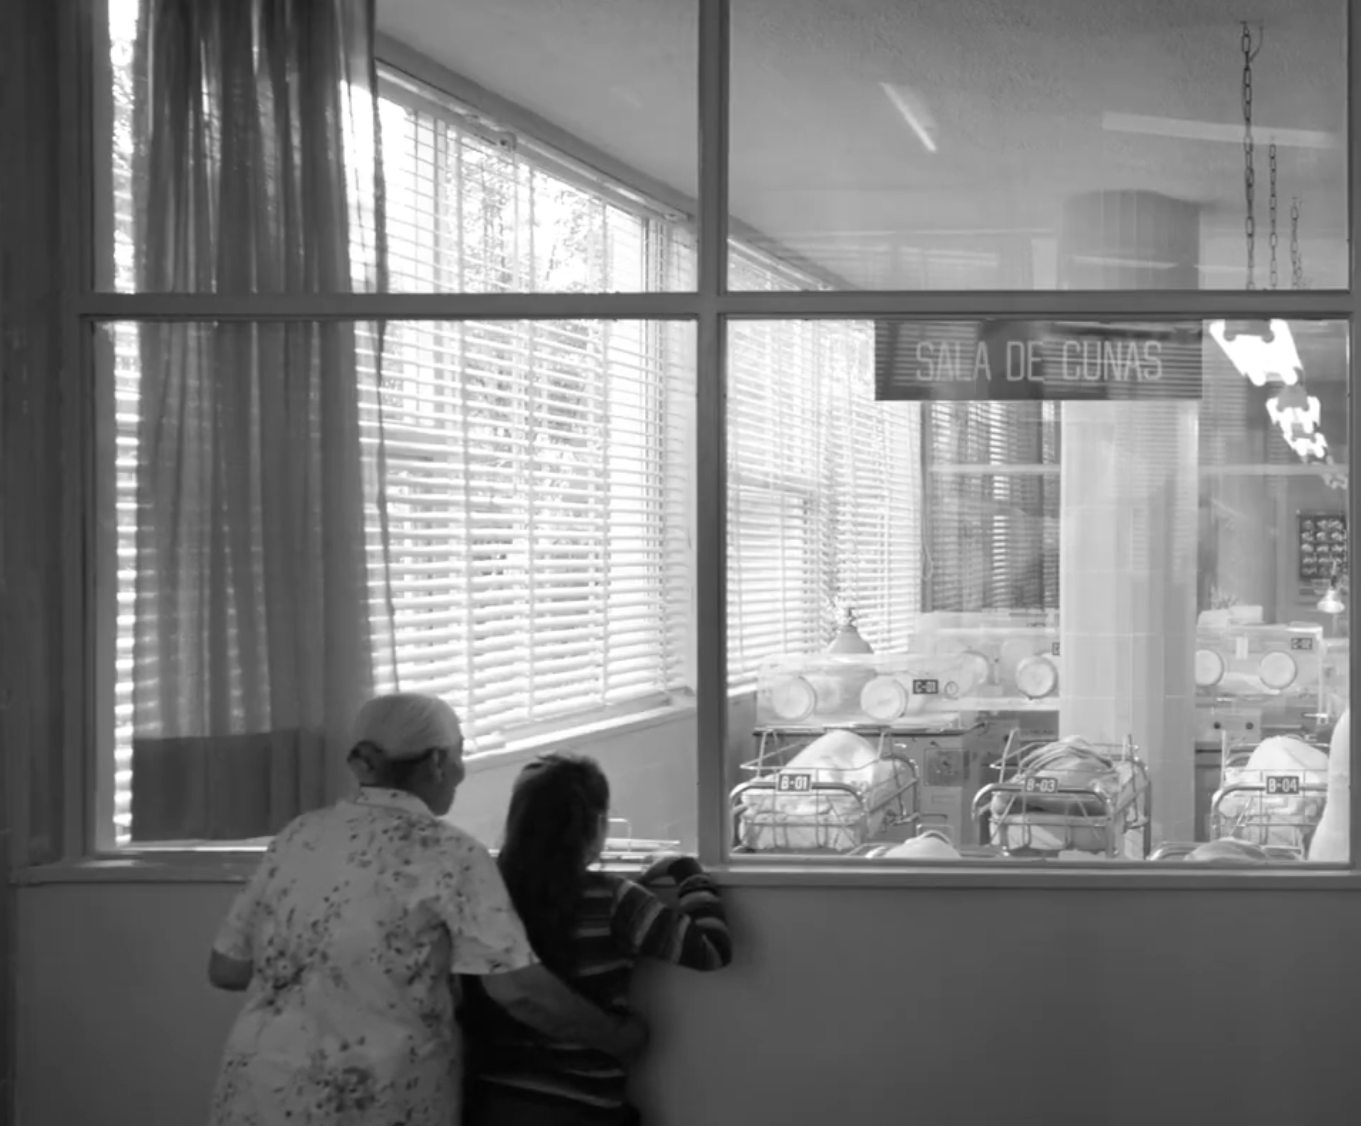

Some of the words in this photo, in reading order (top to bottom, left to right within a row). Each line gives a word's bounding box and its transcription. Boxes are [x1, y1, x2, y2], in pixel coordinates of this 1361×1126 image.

[915, 340, 992, 382] SALA
[1005, 340, 1045, 382] DE
[1061, 340, 1163, 382] CUNAS
[915, 681, 937, 693] C-01
[780, 775, 808, 790] B-01
[1026, 778, 1055, 792] B-03
[1268, 778, 1297, 792] B-04
